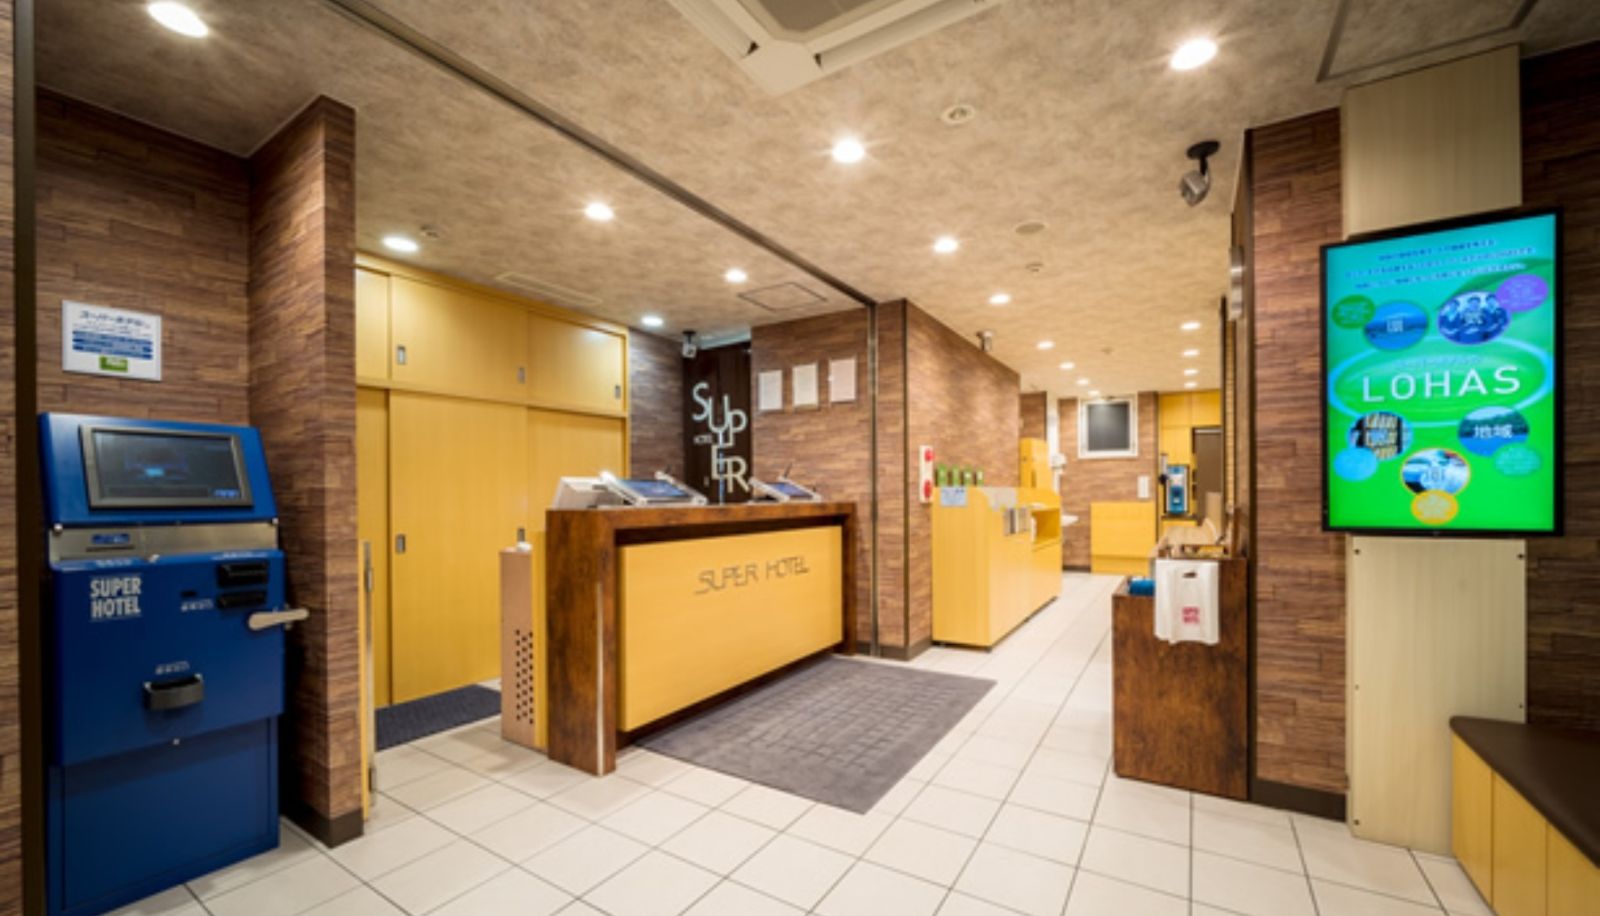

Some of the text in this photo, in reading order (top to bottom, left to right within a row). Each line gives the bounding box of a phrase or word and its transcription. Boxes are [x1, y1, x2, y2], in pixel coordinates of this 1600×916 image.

[1362, 365, 1521, 402] LOHAS
[692, 381, 749, 493] SUPER
[1474, 423, 1513, 439] 地域
[90, 577, 142, 599] SUPER
[695, 556, 810, 595] SUPER HOTEL
[91, 597, 141, 618] HOTEL
